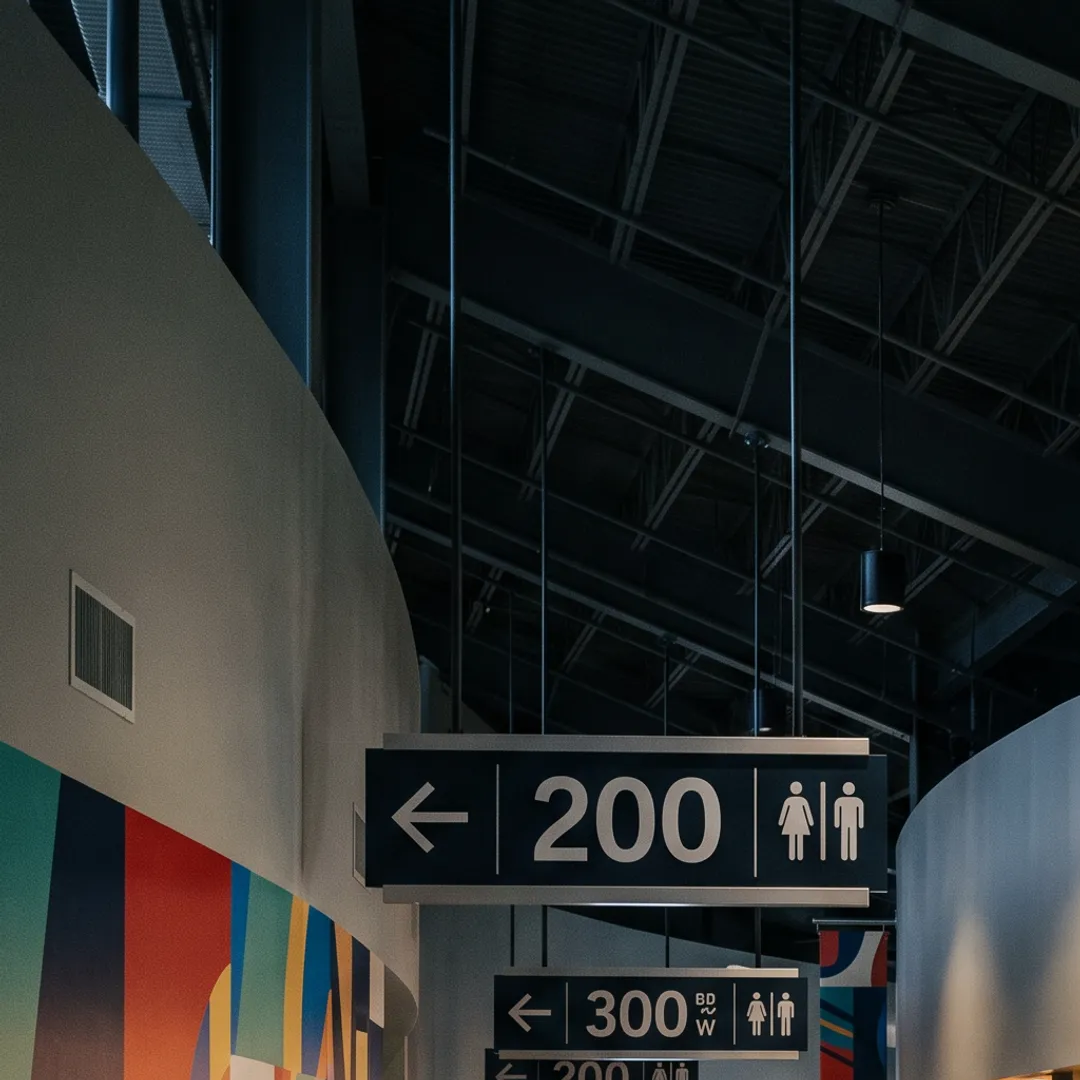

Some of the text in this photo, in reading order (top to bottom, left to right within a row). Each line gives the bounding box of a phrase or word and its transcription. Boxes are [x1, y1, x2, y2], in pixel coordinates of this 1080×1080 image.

[533, 775, 722, 863] 200
[586, 990, 688, 1038] 300
[695, 992, 716, 1006] BD
[695, 1018, 717, 1037] W
